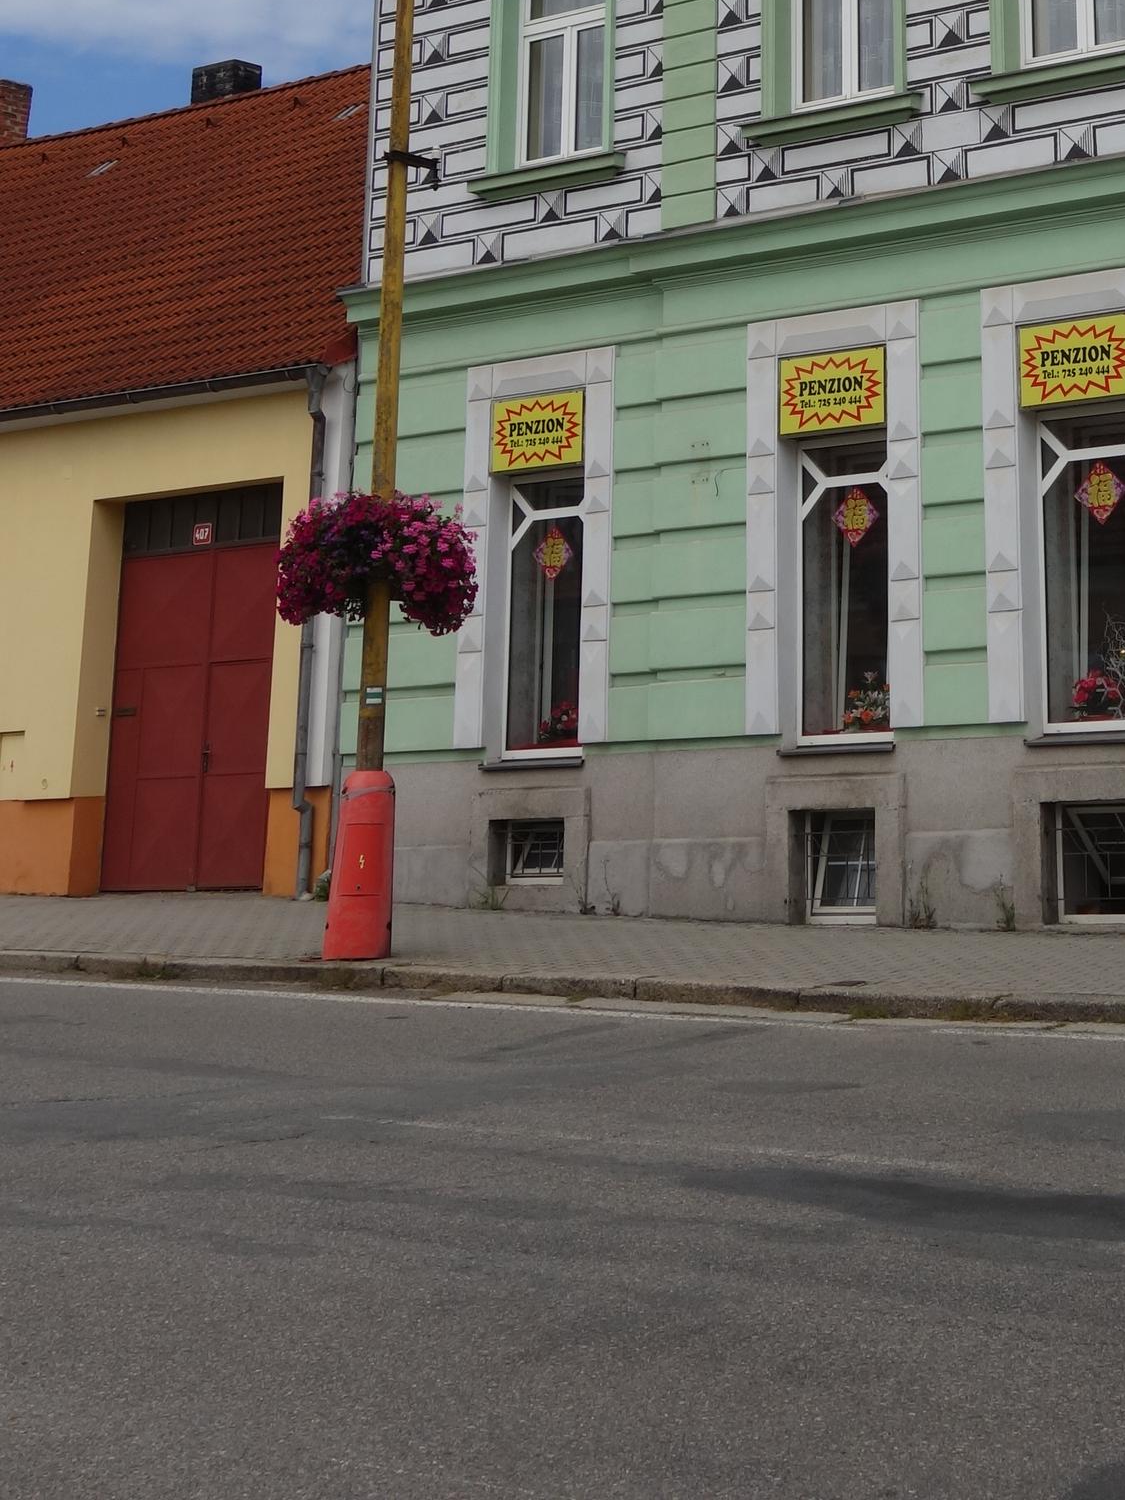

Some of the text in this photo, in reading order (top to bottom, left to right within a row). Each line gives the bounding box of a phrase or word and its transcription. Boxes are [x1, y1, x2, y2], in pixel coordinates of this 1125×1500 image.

[1040, 344, 1112, 368] PENZION
[1042, 364, 1110, 380] Tel.: 725 240 444
[798, 375, 864, 397] PENZION
[800, 395, 862, 409] Tel.: 725 240 444
[508, 417, 566, 438] PENZION
[525, 438, 537, 448] 725
[538, 436, 550, 446] 240
[551, 435, 563, 445] 444
[195, 527, 209, 541] 407
